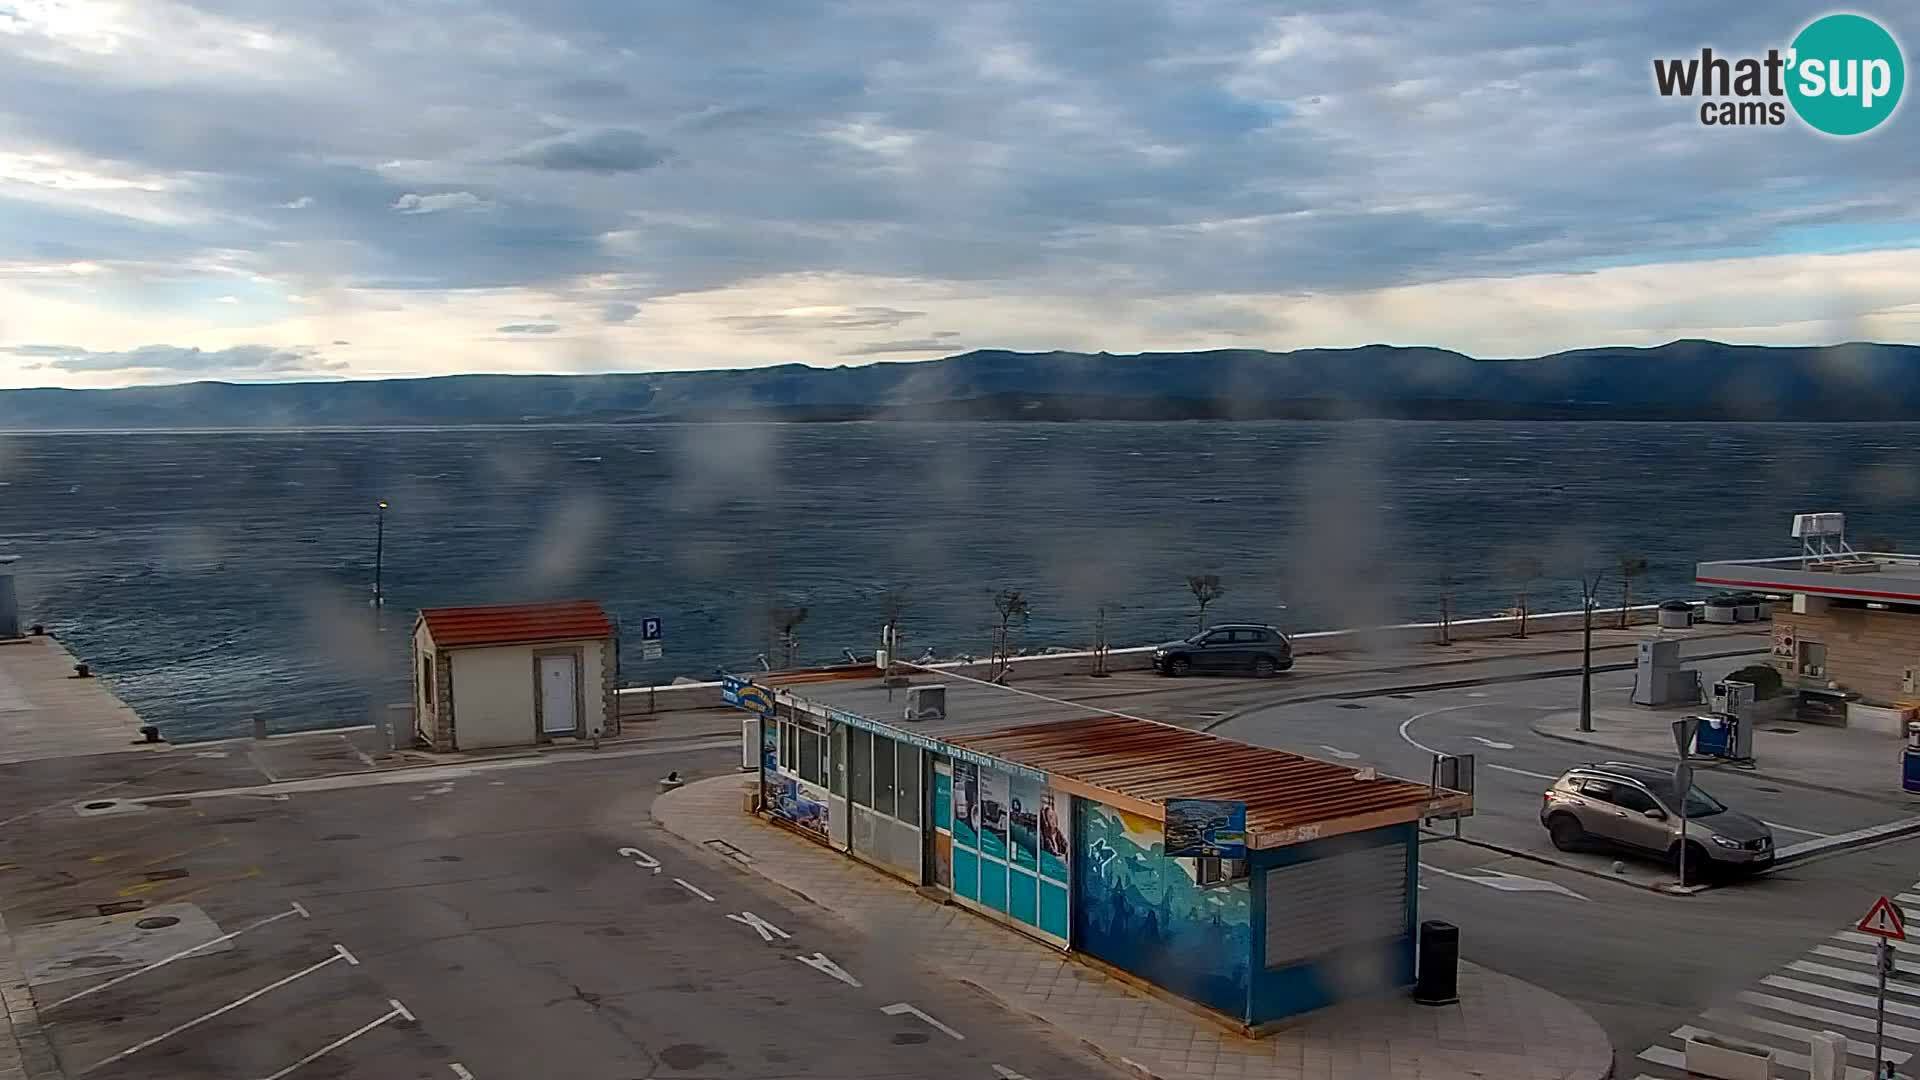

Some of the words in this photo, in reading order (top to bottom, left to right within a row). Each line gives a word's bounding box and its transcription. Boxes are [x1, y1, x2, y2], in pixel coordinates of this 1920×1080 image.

[646, 621, 658, 638] P
[946, 746, 962, 758] BUS
[962, 750, 992, 767] STATION
